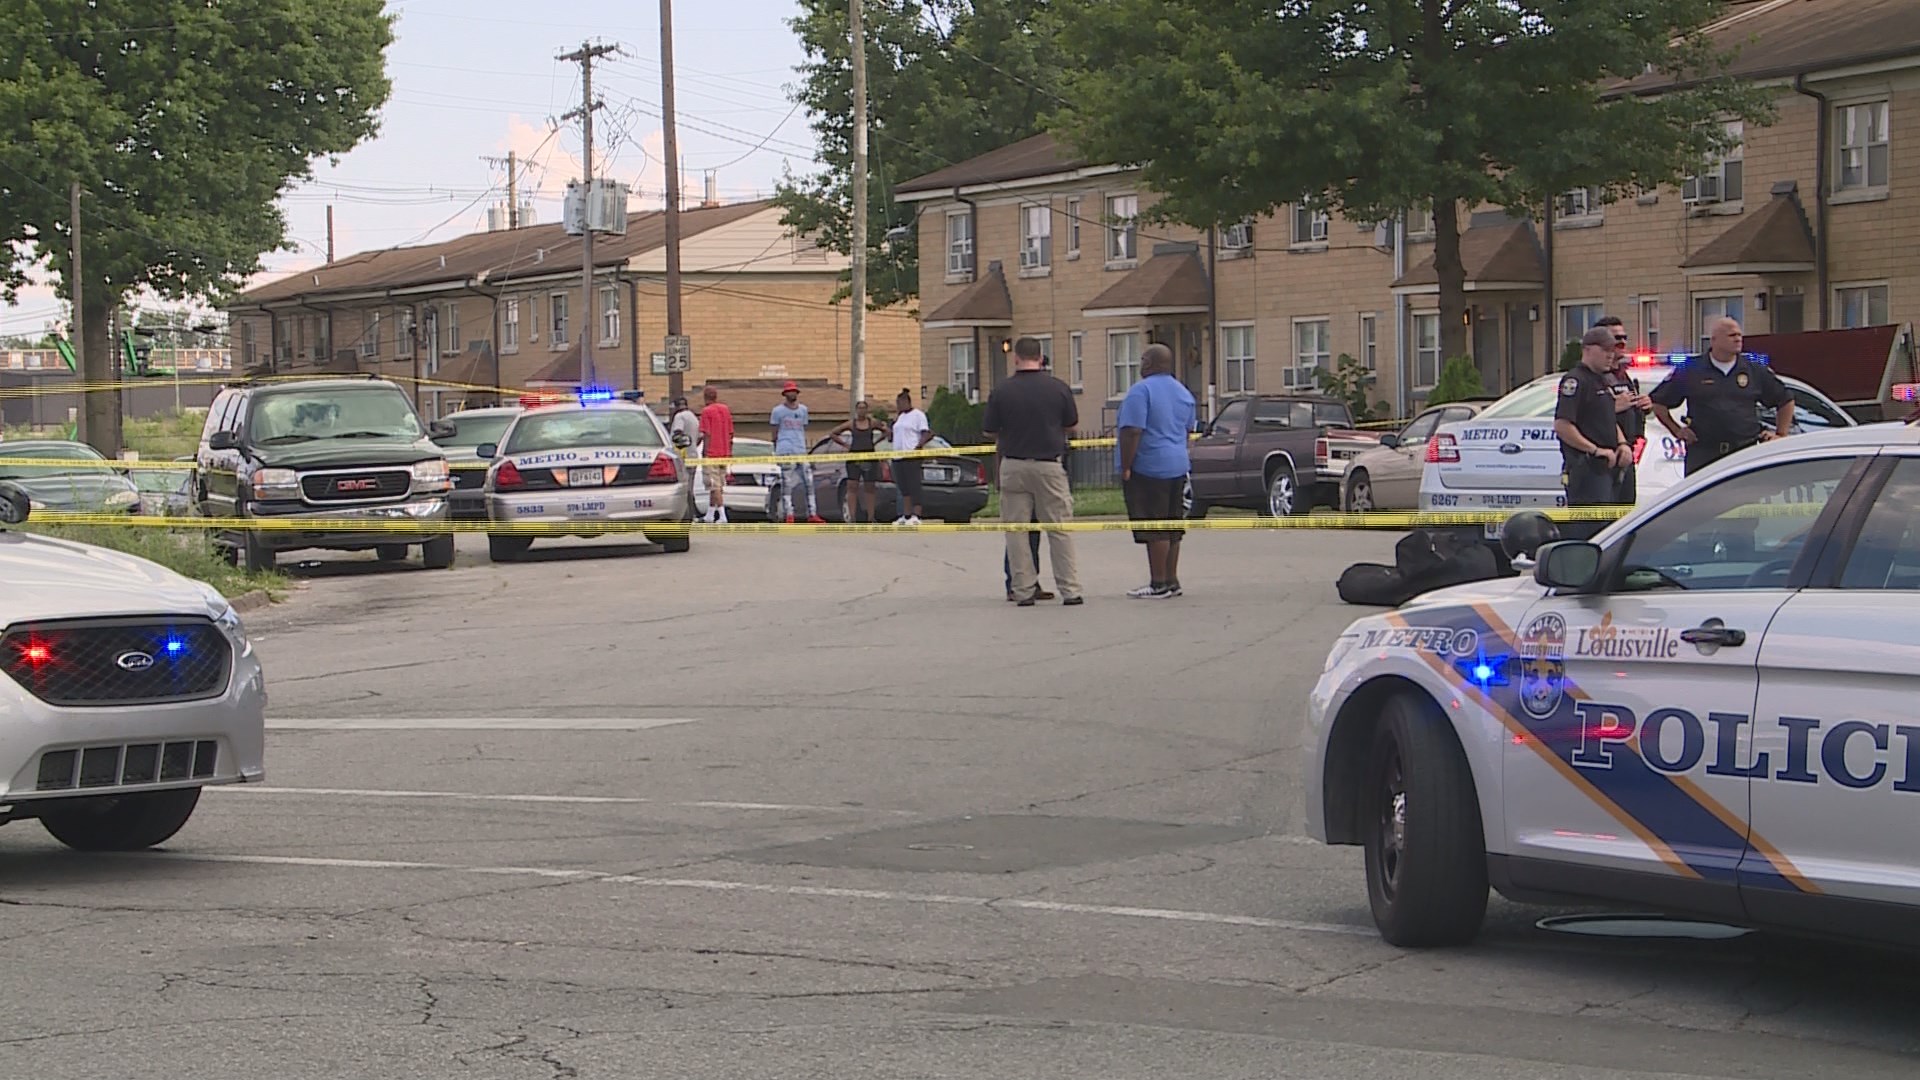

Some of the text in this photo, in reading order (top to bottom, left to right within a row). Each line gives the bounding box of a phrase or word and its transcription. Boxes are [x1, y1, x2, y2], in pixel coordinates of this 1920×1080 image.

[668, 347, 687, 355] LIMIT
[668, 355, 688, 369] 25
[1461, 428, 1560, 441] METRO POLI
[1661, 436, 1686, 460] 91
[519, 450, 652, 466] METRO POLICE
[337, 478, 377, 491] GMC
[634, 499, 653, 509] 911
[1431, 494, 1459, 507] 6267
[1528, 615, 1563, 641] POLICE
[1359, 627, 1479, 657] METRO
[1575, 627, 1679, 658] Louisville
[1521, 643, 1563, 657] LOUISVILLE
